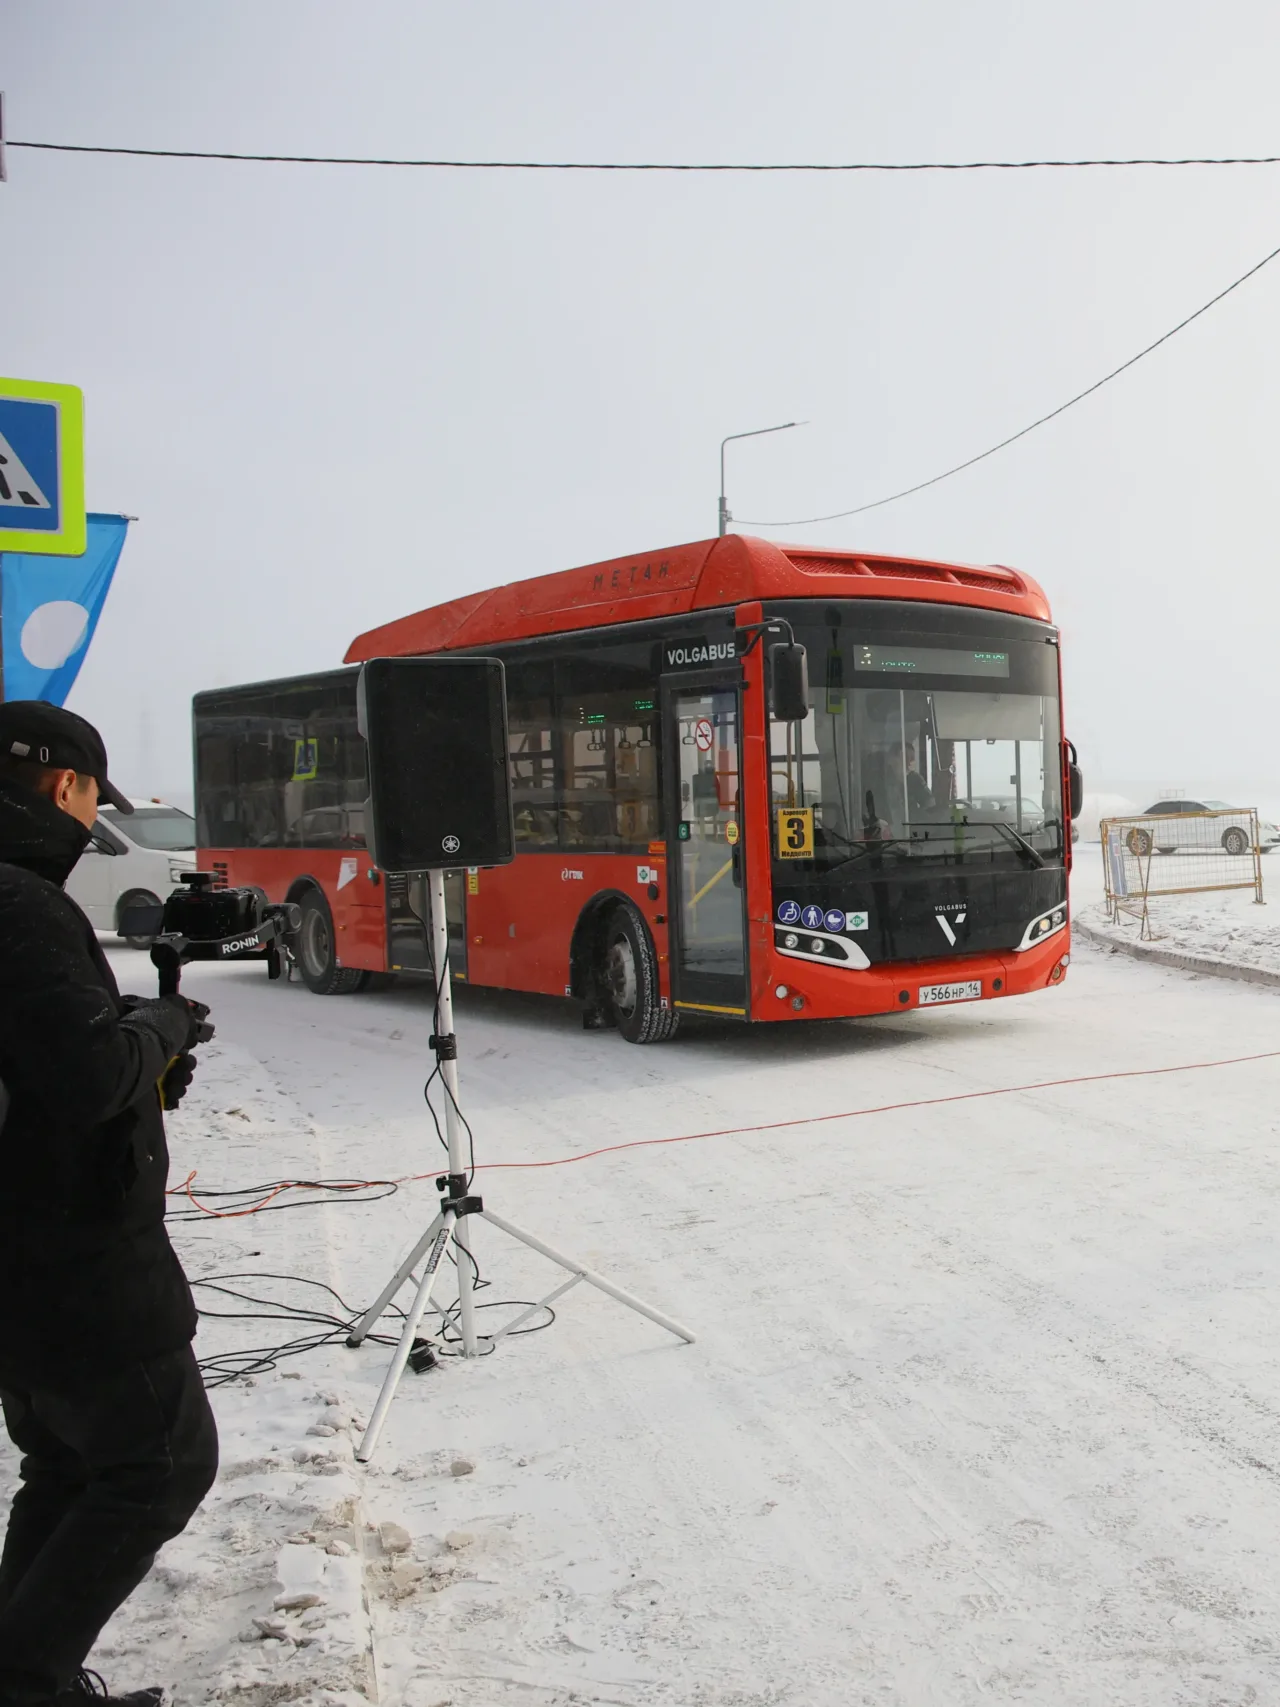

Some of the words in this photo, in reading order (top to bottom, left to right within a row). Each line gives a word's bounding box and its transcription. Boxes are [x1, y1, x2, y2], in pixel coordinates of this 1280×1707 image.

[593, 561, 669, 591] МЕТАН
[667, 642, 735, 665] VOLGABUS
[787, 817, 805, 849] 3
[934, 903, 967, 912] VOLGABUS
[222, 934, 259, 954] RONIN
